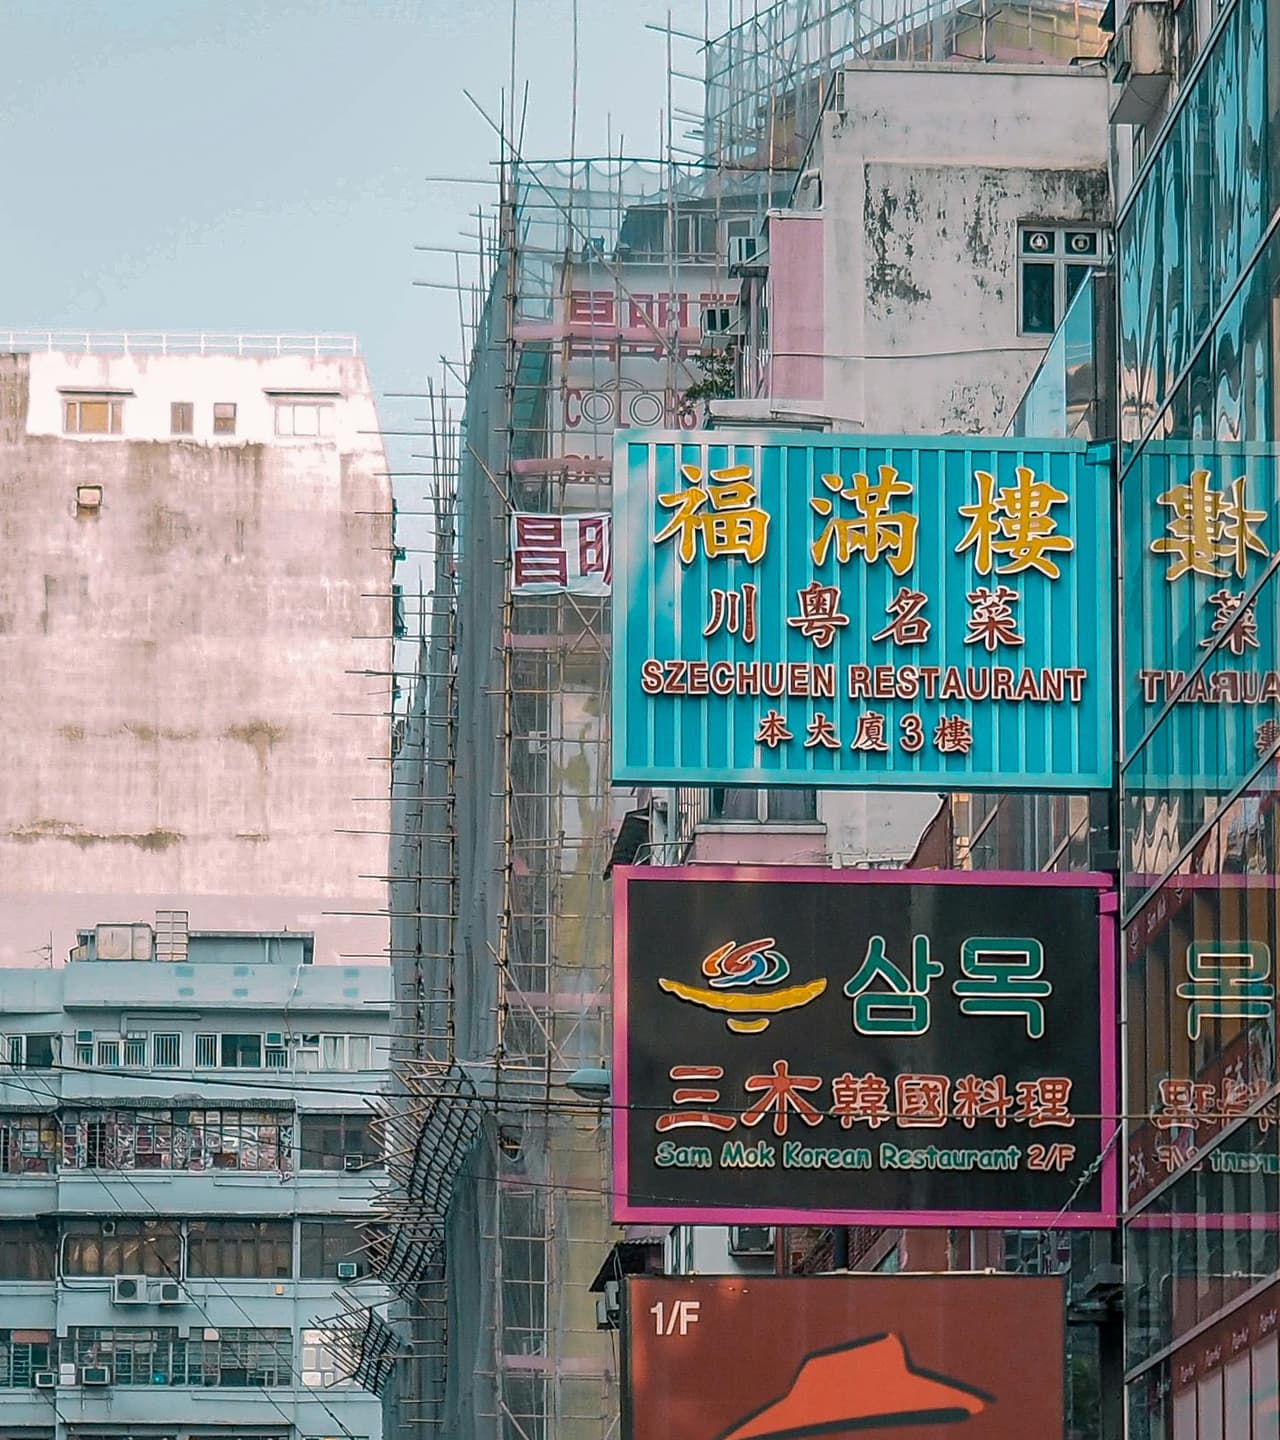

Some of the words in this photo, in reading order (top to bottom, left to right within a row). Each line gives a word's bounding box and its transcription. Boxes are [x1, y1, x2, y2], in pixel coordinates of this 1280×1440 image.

[654, 464, 1074, 580] 福滿樓
[703, 581, 1025, 653] 川粵名菜
[640, 660, 835, 698] SZECHUEN
[848, 664, 1088, 703] RESTAURANT
[755, 709, 973, 756] 本大廈3樓
[844, 934, 1053, 1039] 삼목
[655, 1059, 1076, 1136] 三木韓國料理
[655, 1140, 713, 1169] Sam
[720, 1140, 775, 1168] Mok
[782, 1142, 870, 1169] Korean
[879, 1142, 1021, 1171] Restaurant
[1025, 1143, 1076, 1173] 2/F
[649, 1300, 700, 1336] 1/F
